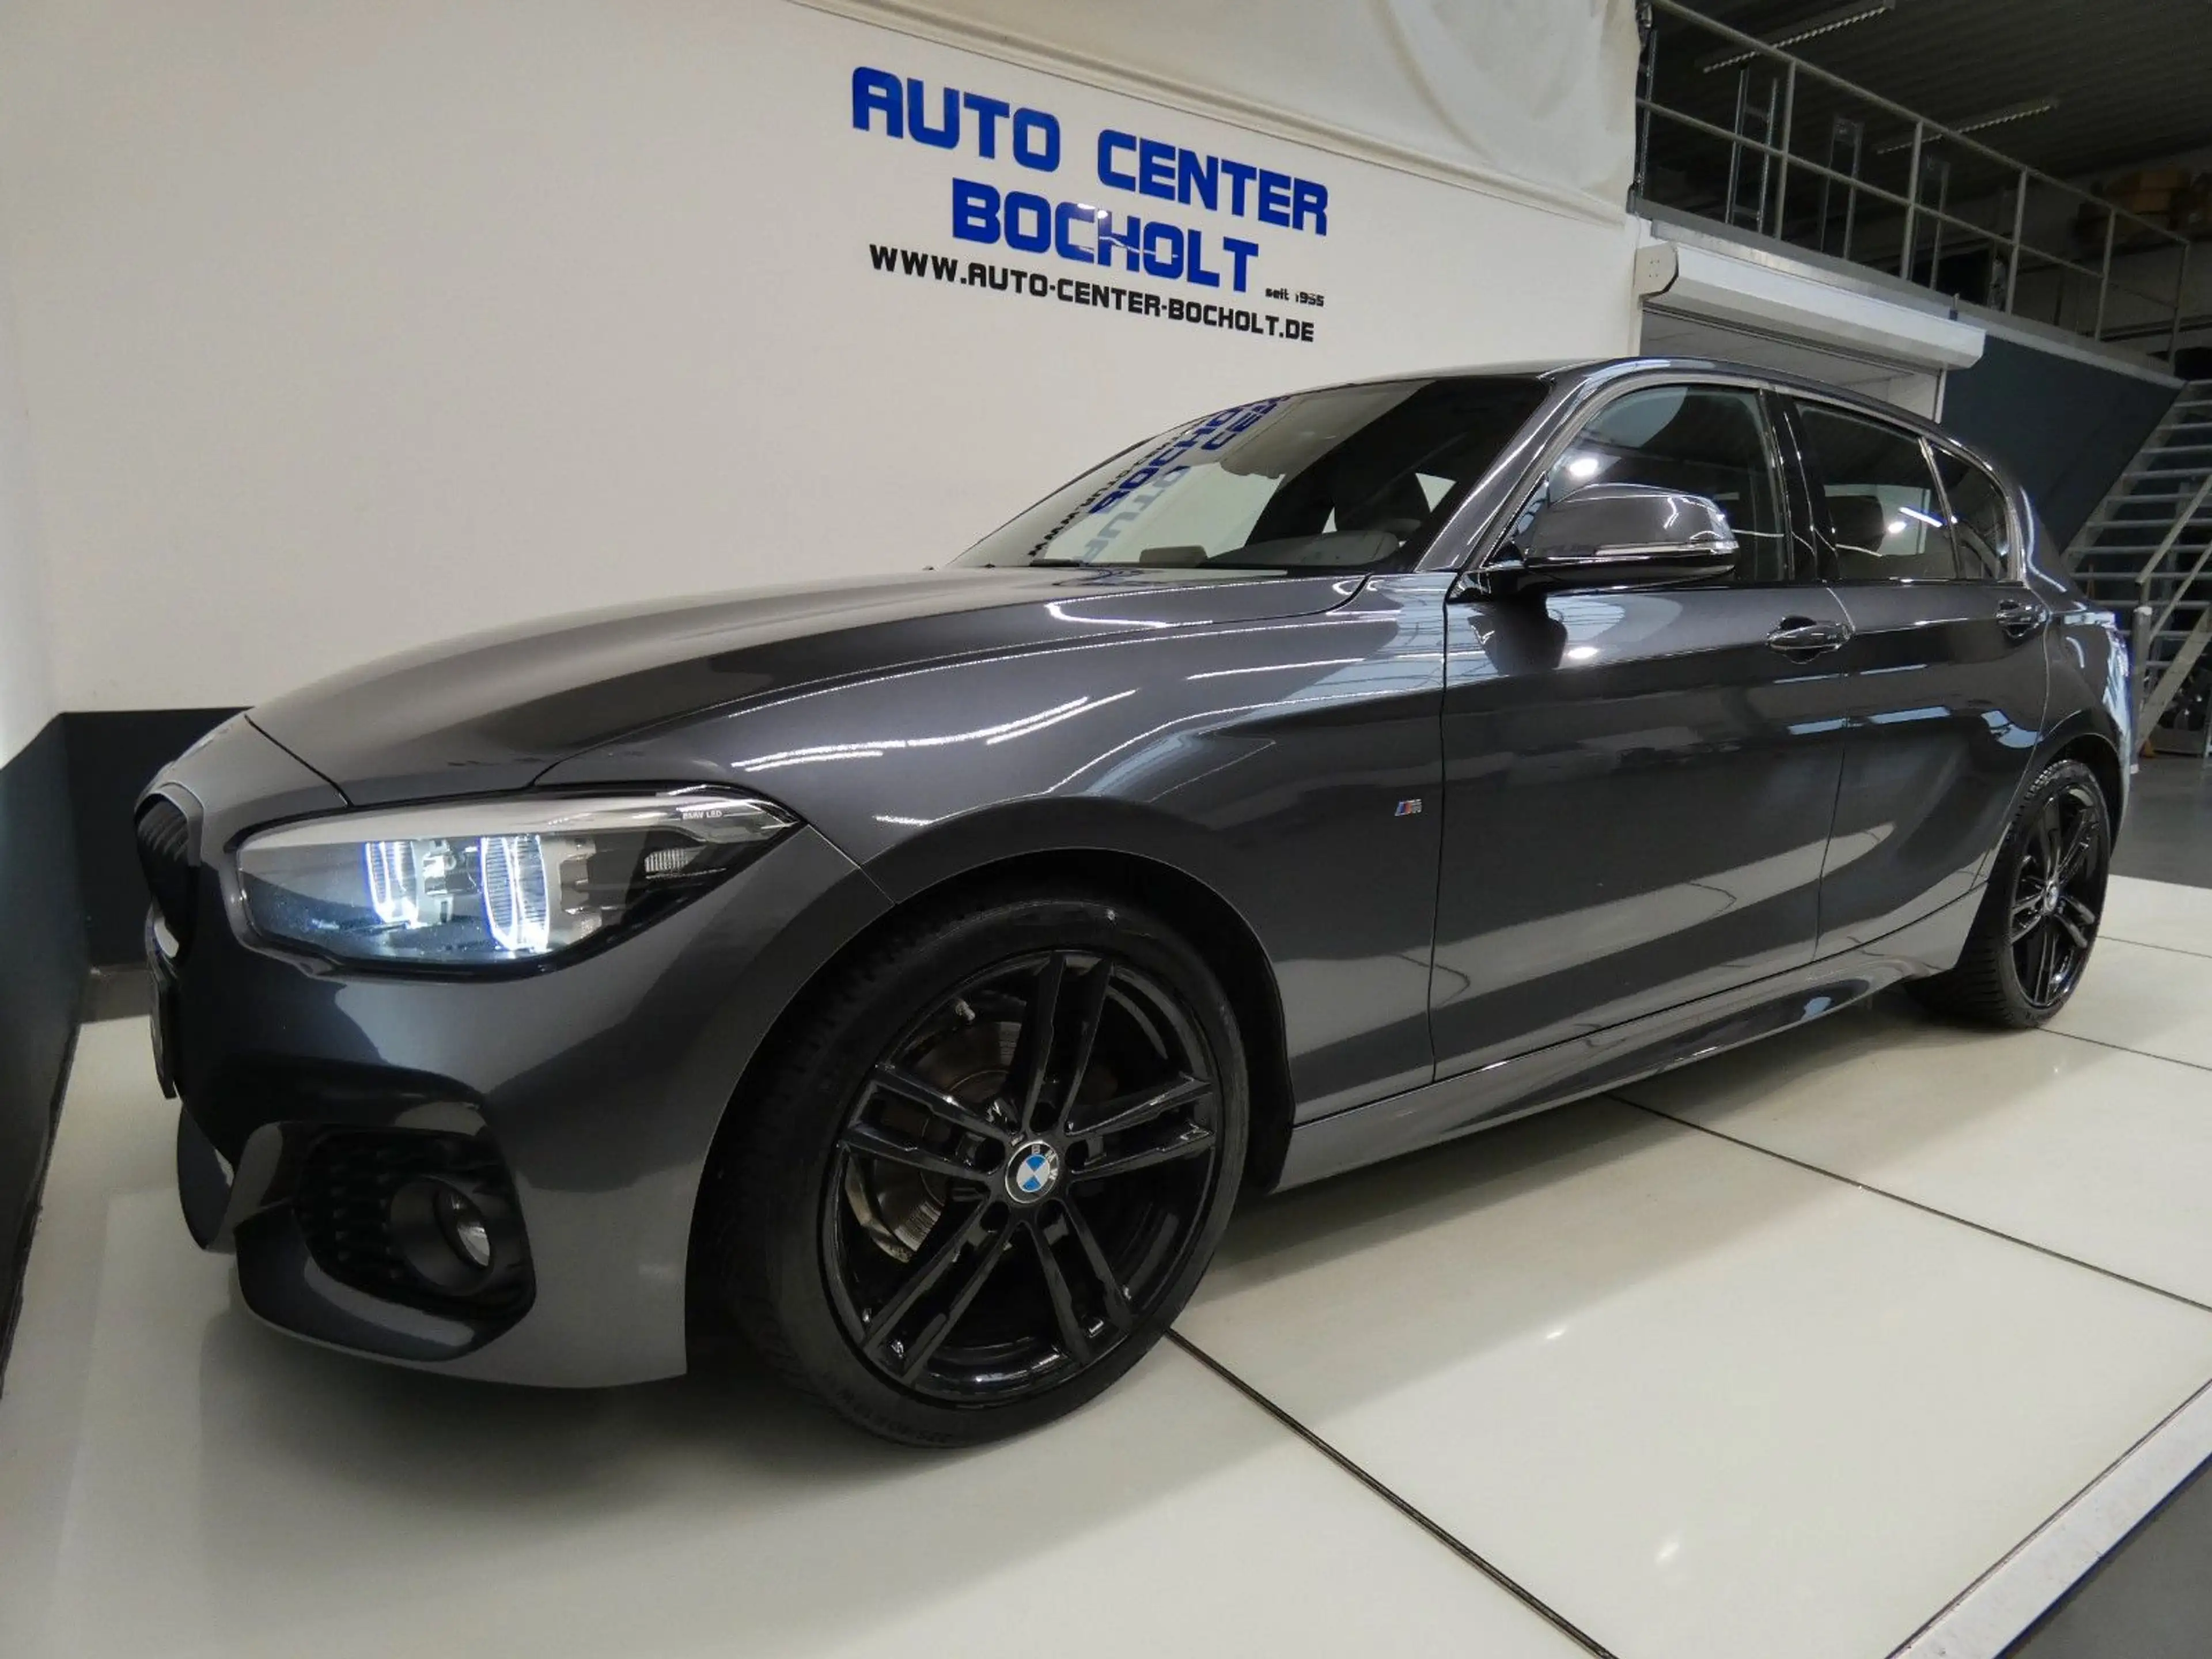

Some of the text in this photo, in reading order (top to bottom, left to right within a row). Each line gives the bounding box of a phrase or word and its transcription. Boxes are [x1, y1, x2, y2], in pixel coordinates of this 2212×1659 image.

[852, 67, 1328, 236] AUTO CENTER
[952, 177, 1259, 293] BOCHOLT
[869, 244, 1315, 342] WWW.AUTO-CENTER-BOCHOLT.DE
[1266, 287, 1289, 301] seit
